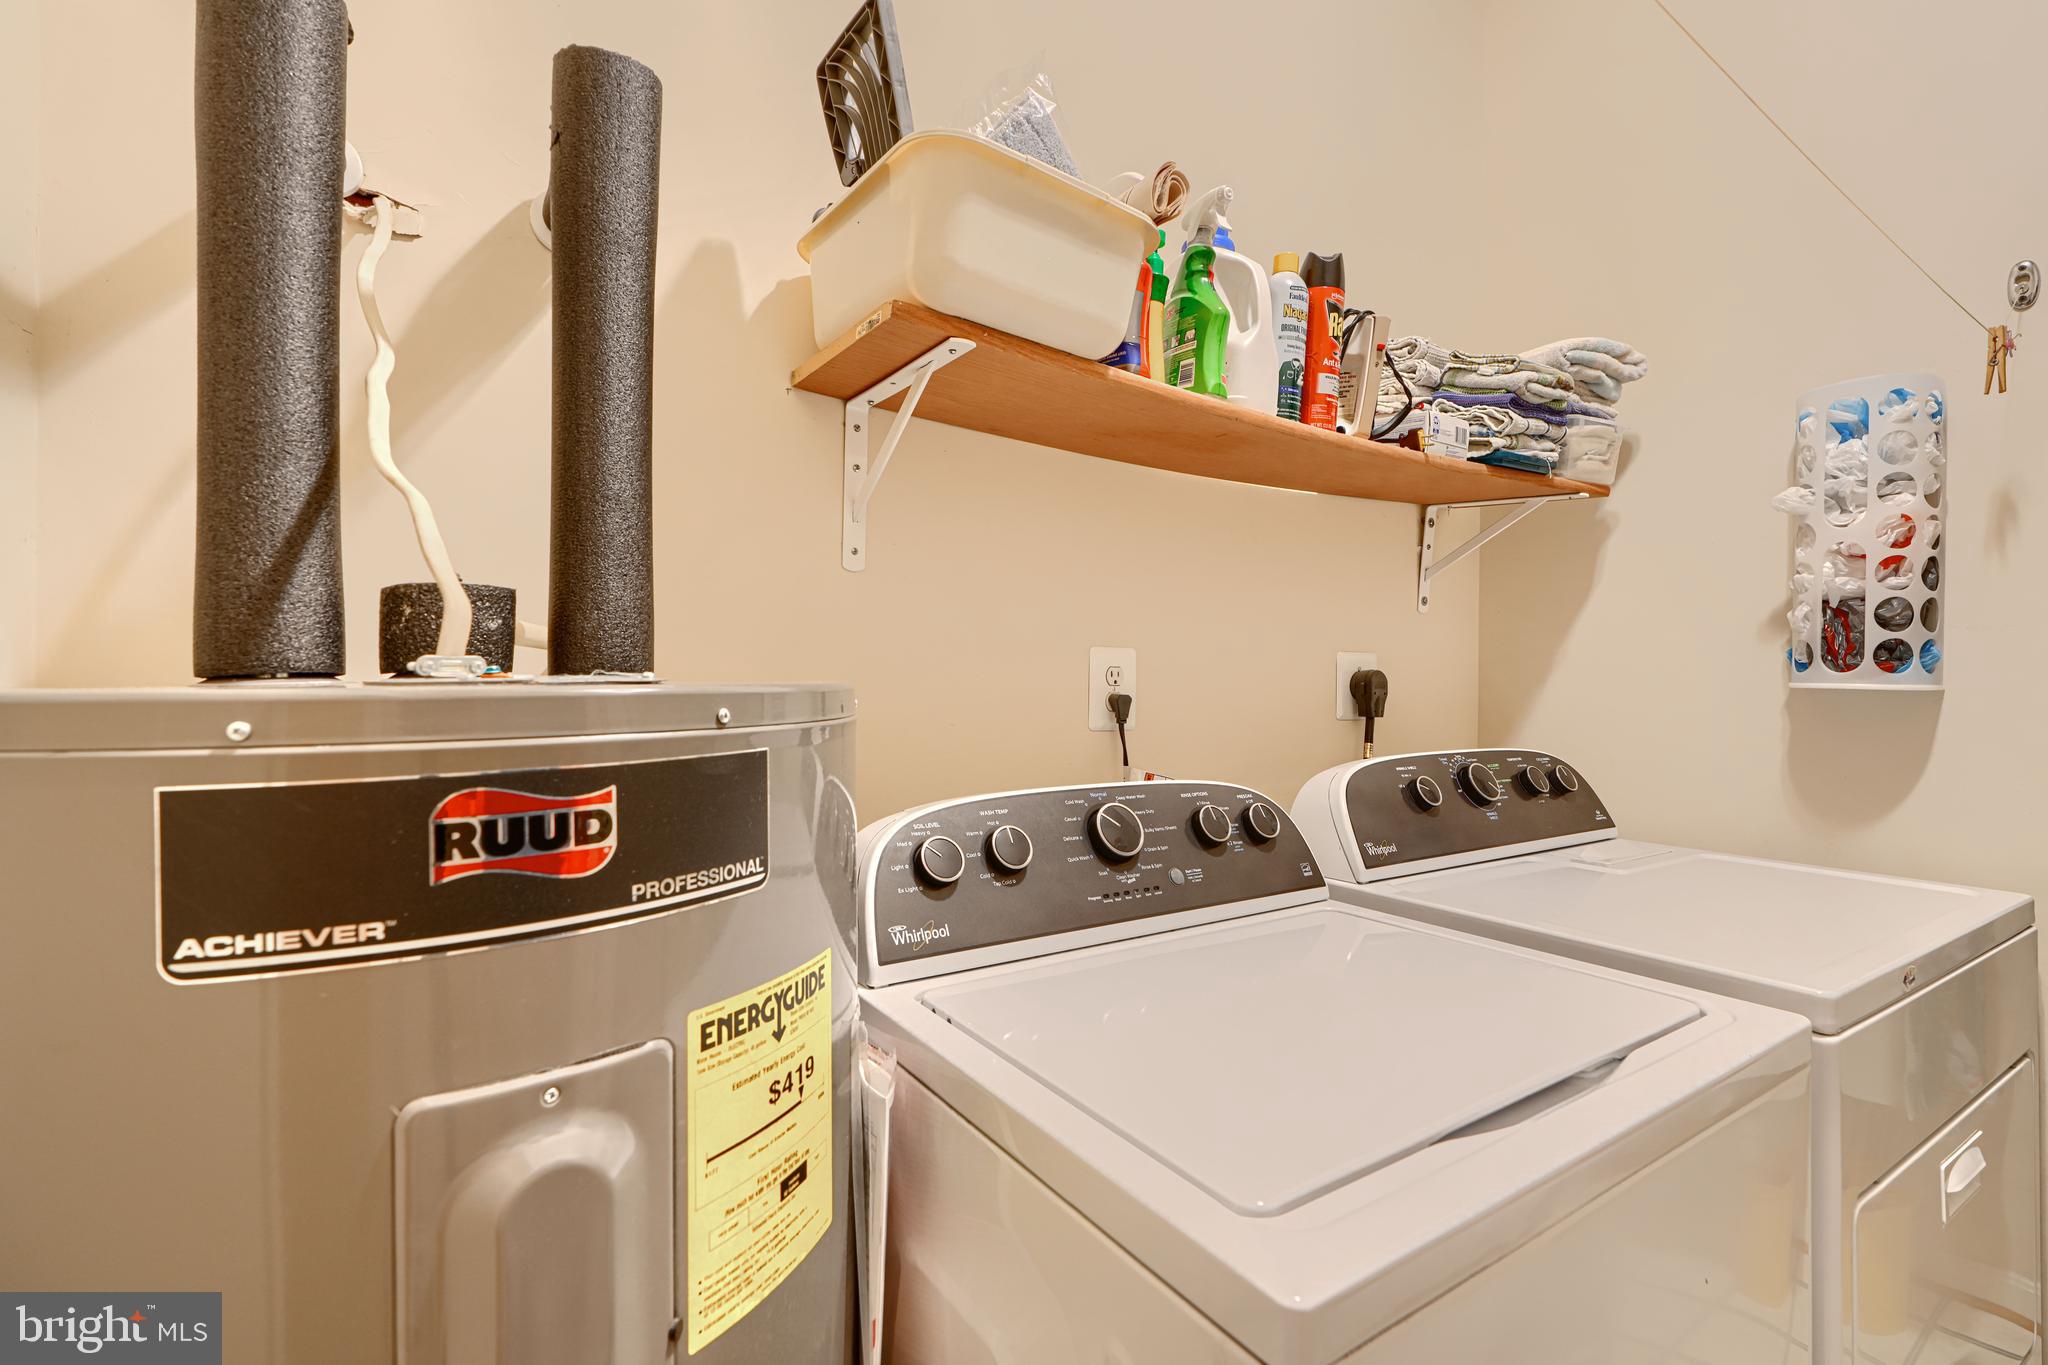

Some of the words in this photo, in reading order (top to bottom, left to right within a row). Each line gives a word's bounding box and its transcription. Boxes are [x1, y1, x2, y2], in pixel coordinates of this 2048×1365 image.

[1283, 304, 1307, 322] Niaga
[1328, 312, 1344, 336] Ra
[434, 809, 613, 862] RUUD
[1366, 843, 1397, 856] Whirlpool
[632, 857, 764, 902] PROFESSIONAL
[173, 921, 386, 960] ACHIEVER
[890, 924, 950, 946] Whirlpool
[700, 964, 825, 1053] ENERGYGUIDE
[769, 1056, 814, 1105] $419
